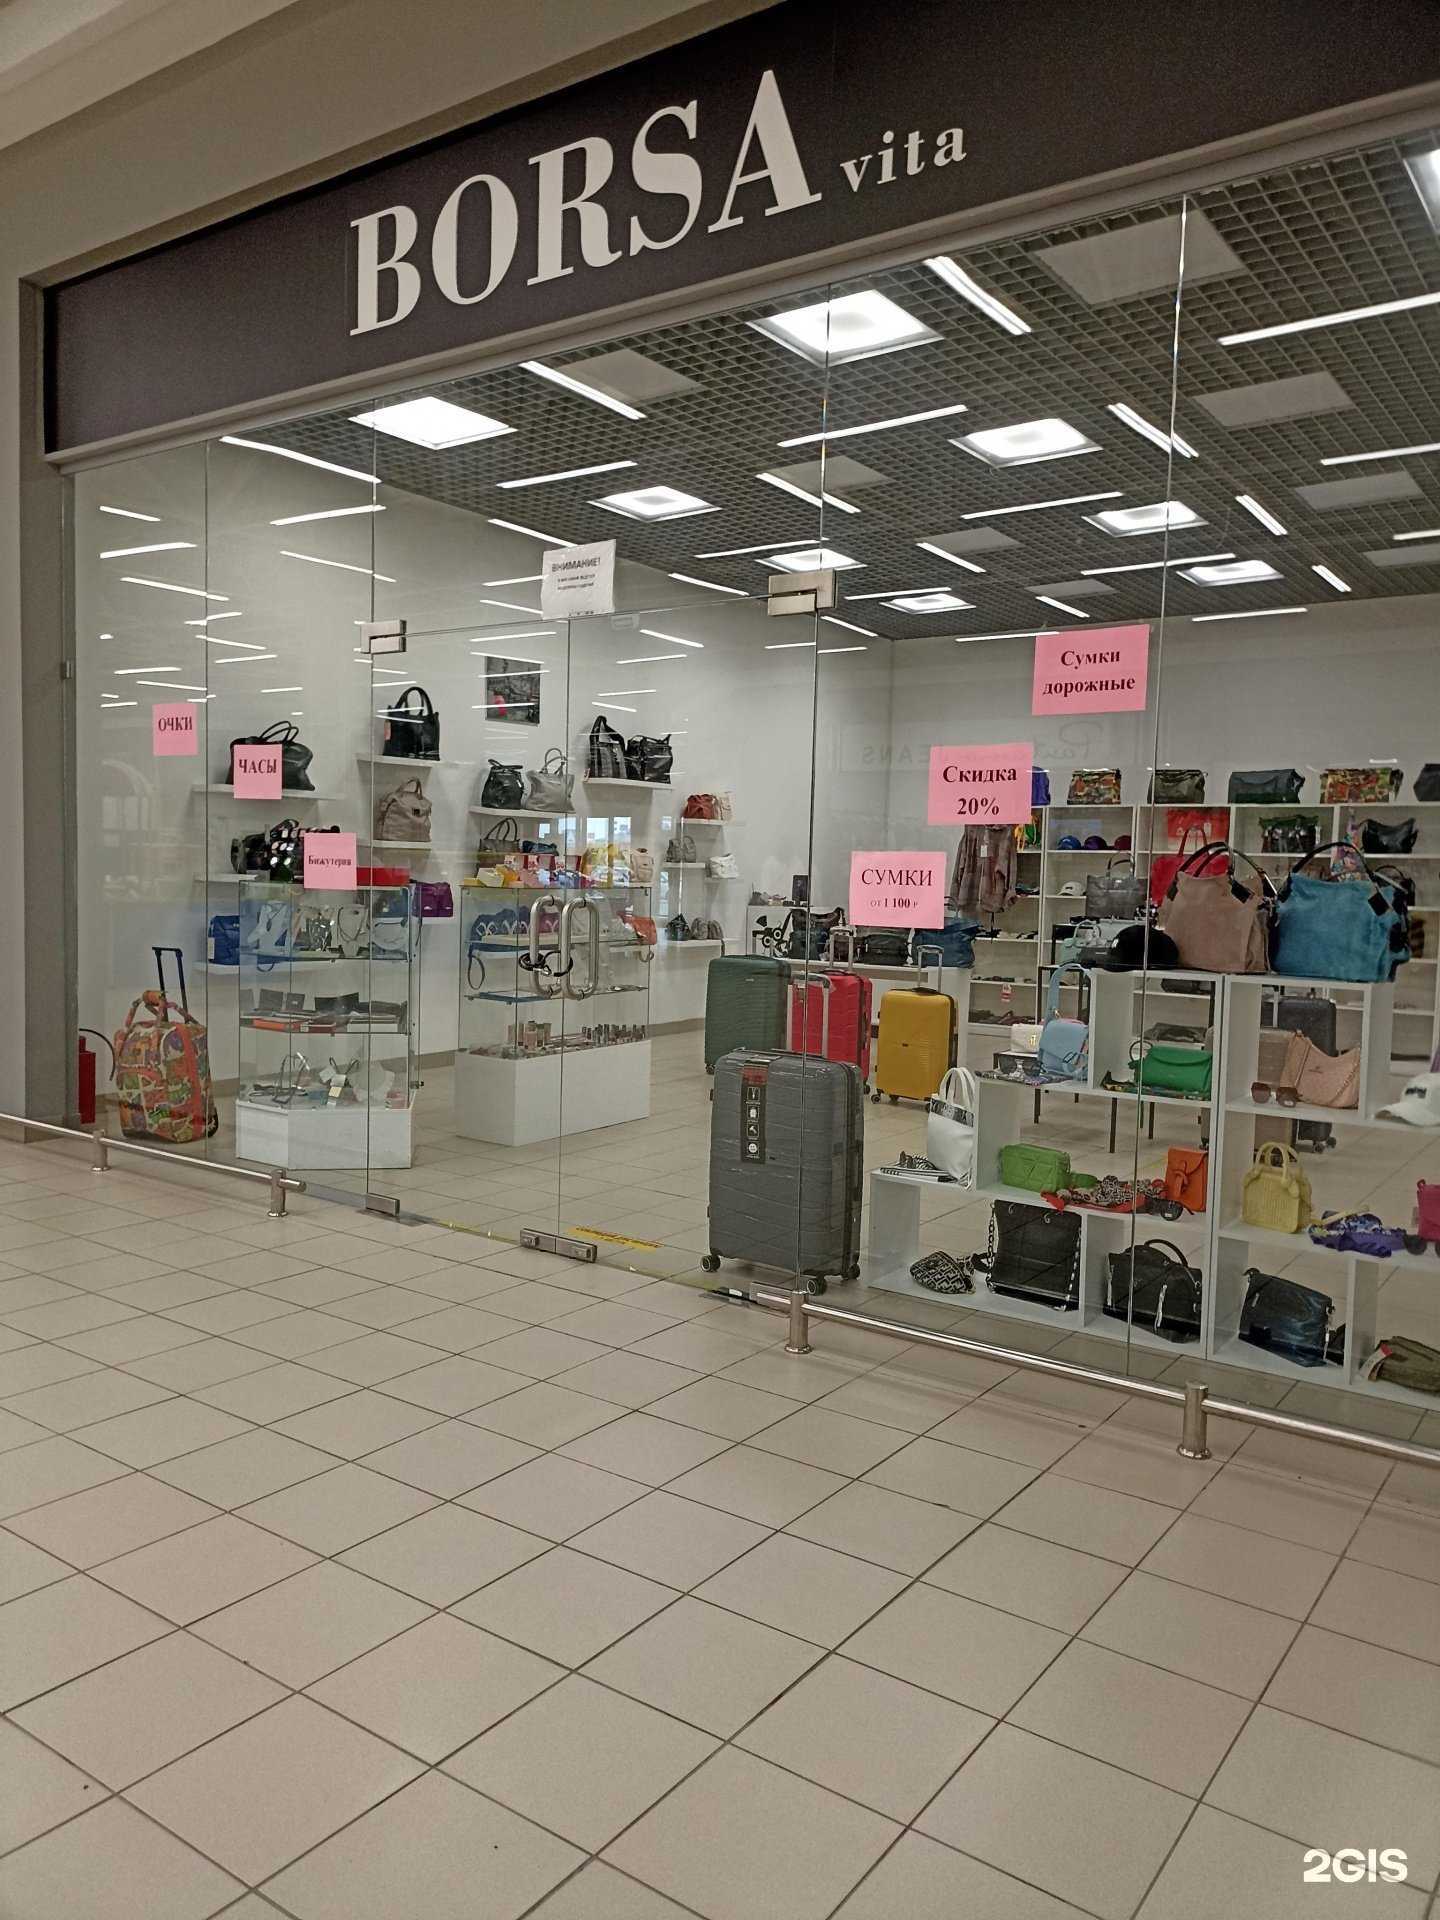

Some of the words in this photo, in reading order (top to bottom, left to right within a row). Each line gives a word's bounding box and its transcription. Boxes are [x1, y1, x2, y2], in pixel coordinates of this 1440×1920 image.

[350, 69, 823, 337] BORSA
[839, 127, 968, 193] vita
[1060, 650, 1121, 670] Сумки
[1042, 676, 1136, 698] дорожные
[157, 716, 194, 732] ОЧКИ
[238, 759, 278, 774] ЧАСЫ
[942, 765, 1018, 784] Скидка
[957, 797, 1001, 816] 20%
[861, 868, 933, 887] СУМКИ
[893, 897, 912, 909] 100
